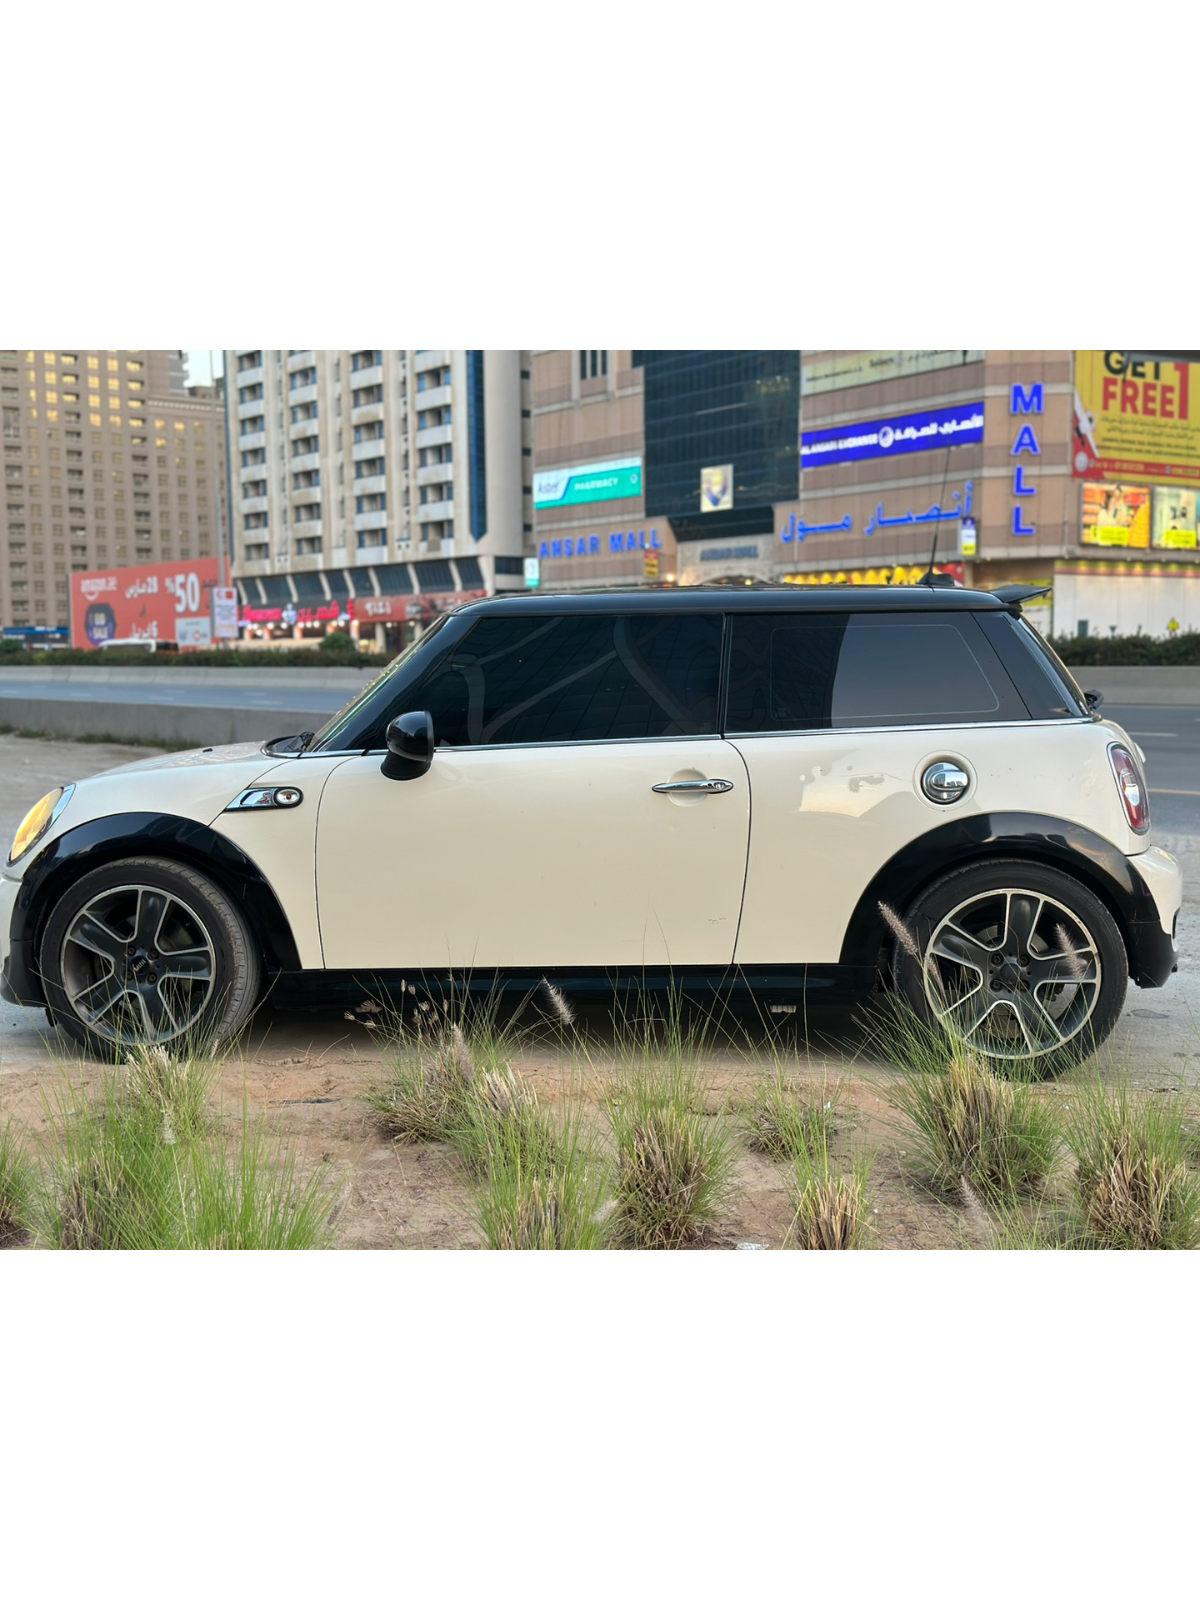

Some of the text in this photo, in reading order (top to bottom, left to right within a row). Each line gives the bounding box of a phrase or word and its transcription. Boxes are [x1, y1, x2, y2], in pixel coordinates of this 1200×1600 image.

[1102, 376, 1175, 420] FREE
[1010, 382, 1045, 536] MALL
[781, 480, 974, 544] أنصار مول
[538, 528, 662, 560] ANSAR MALL
